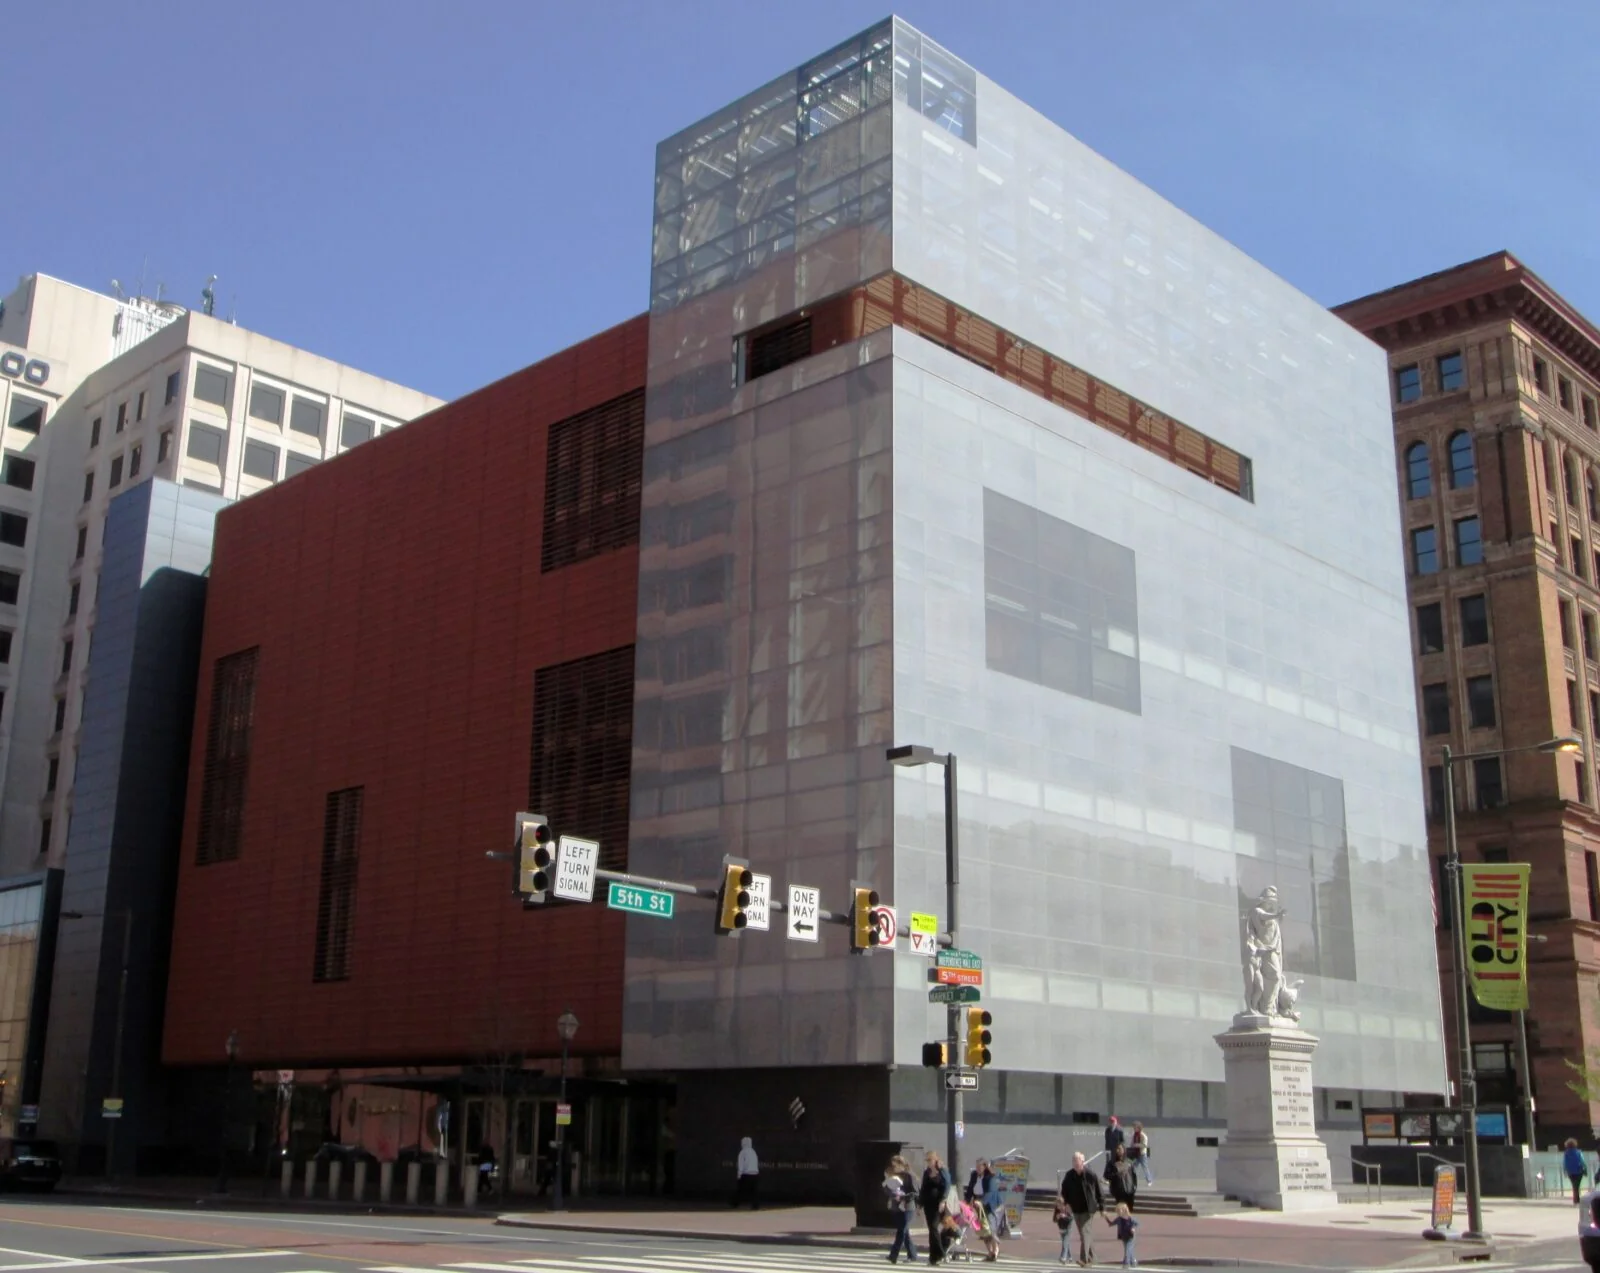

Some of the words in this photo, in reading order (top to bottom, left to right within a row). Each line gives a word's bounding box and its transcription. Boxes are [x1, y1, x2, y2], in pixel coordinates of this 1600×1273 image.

[565, 845, 592, 859] LEFT
[563, 861, 590, 877] TURN
[558, 877, 589, 893] SIGNAL
[749, 881, 766, 893] EFT
[617, 888, 643, 908] 5th
[649, 894, 666, 911] St
[749, 895, 766, 908] URN
[794, 890, 815, 905] ONE
[793, 904, 815, 919] WAY
[1471, 902, 1494, 964] OLD
[1496, 903, 1519, 965] CITY
[957, 974, 979, 983] STREET
[929, 990, 954, 1002] MARKET
